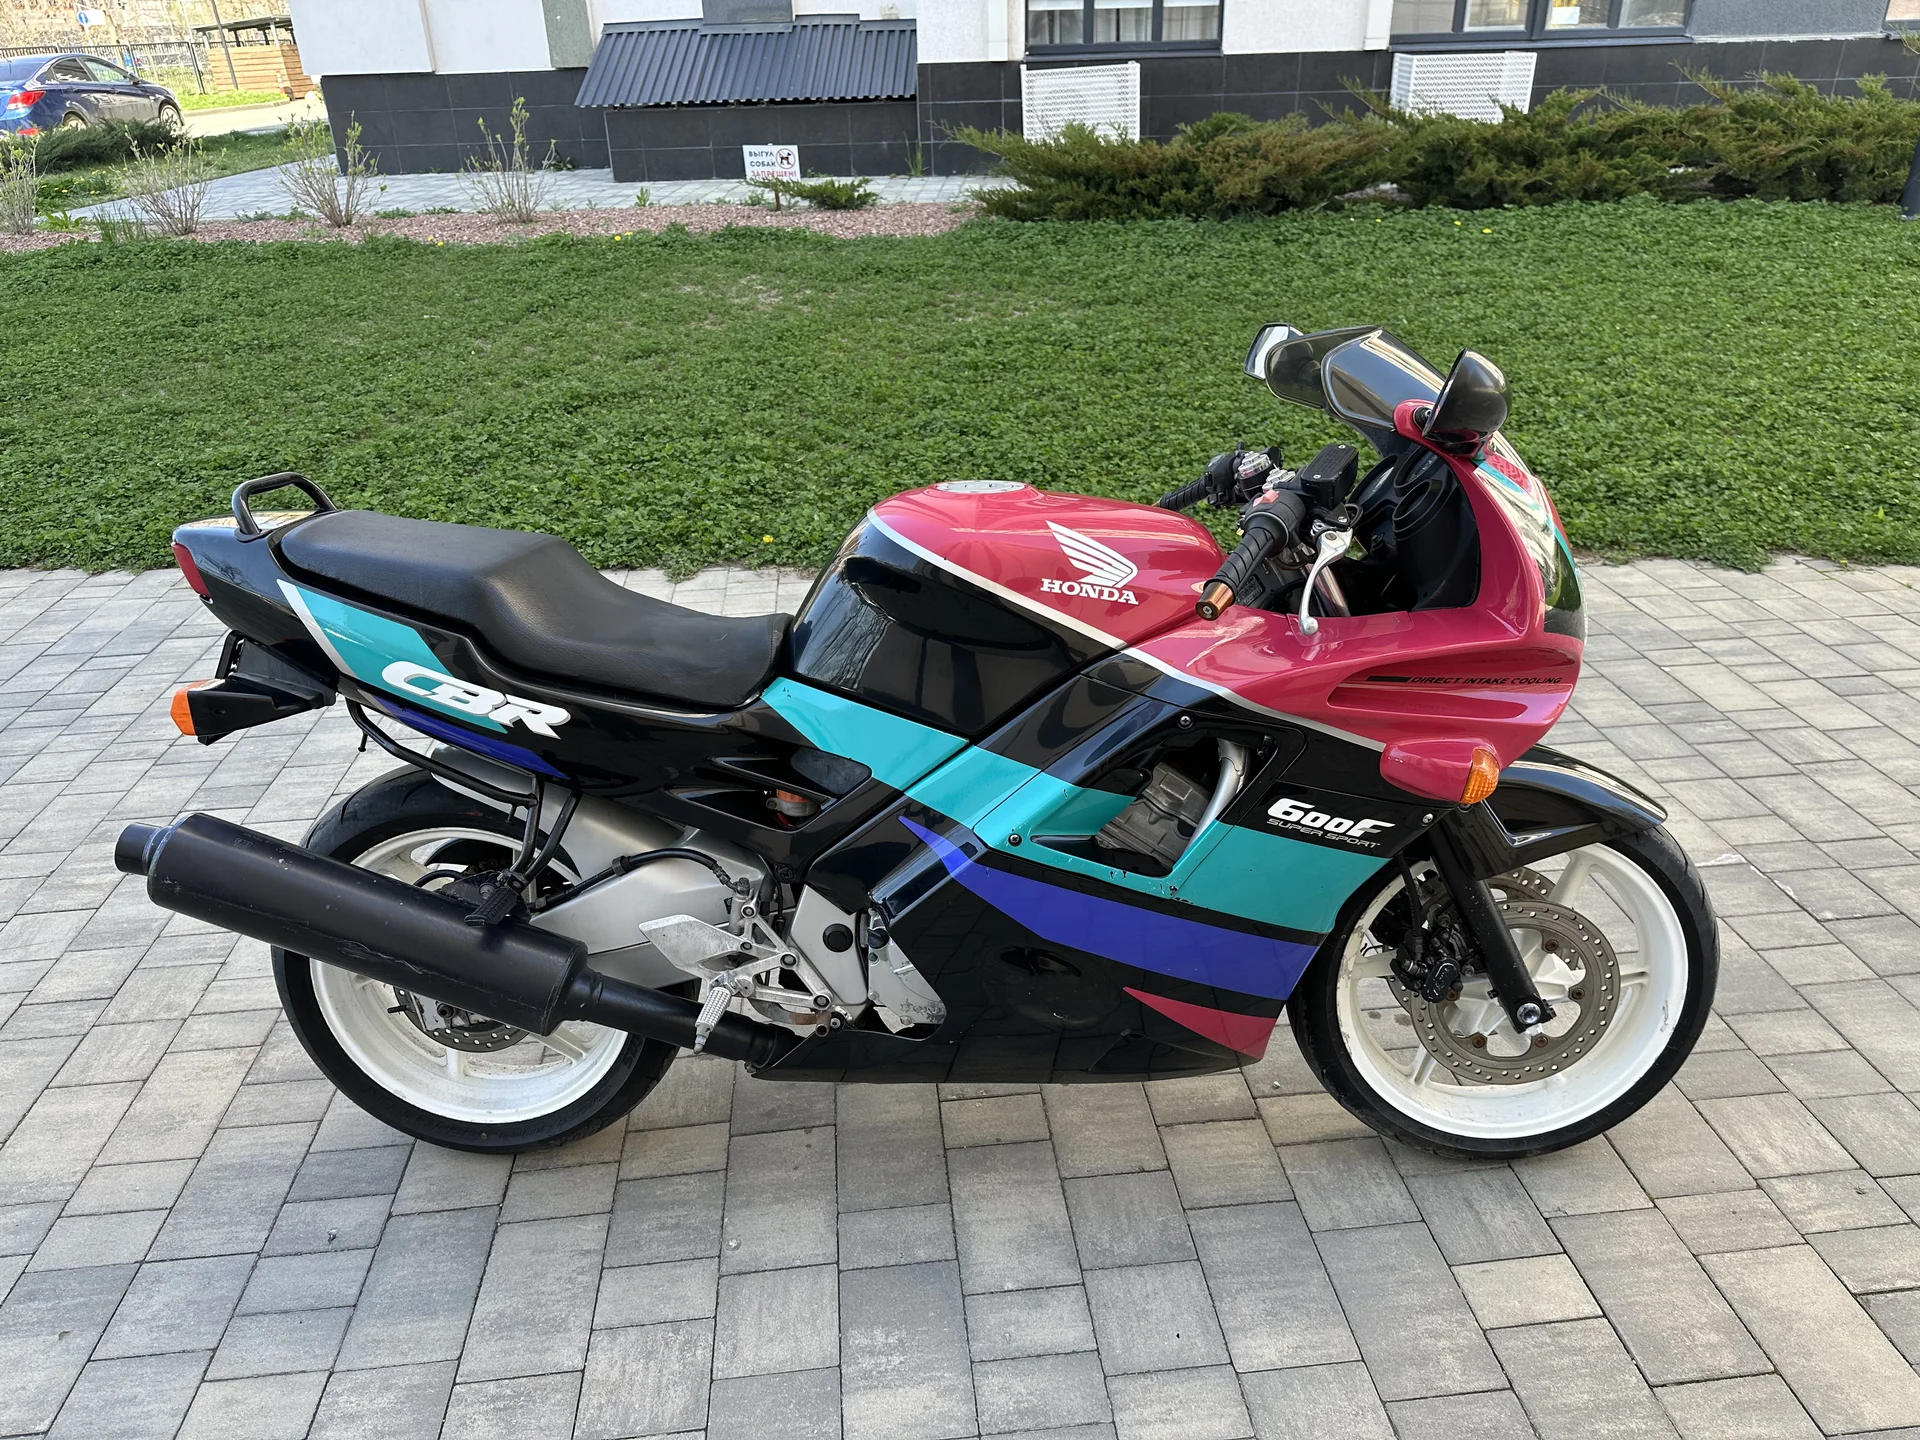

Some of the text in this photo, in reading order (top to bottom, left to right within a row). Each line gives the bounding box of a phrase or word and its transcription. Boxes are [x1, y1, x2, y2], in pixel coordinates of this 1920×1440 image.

[1040, 578, 1139, 605] HONDA
[1411, 676, 1463, 684] DIRECT
[381, 660, 571, 740] CBR
[1267, 798, 1396, 837] 600F
[1266, 818, 1381, 848] SUPER SPORT
